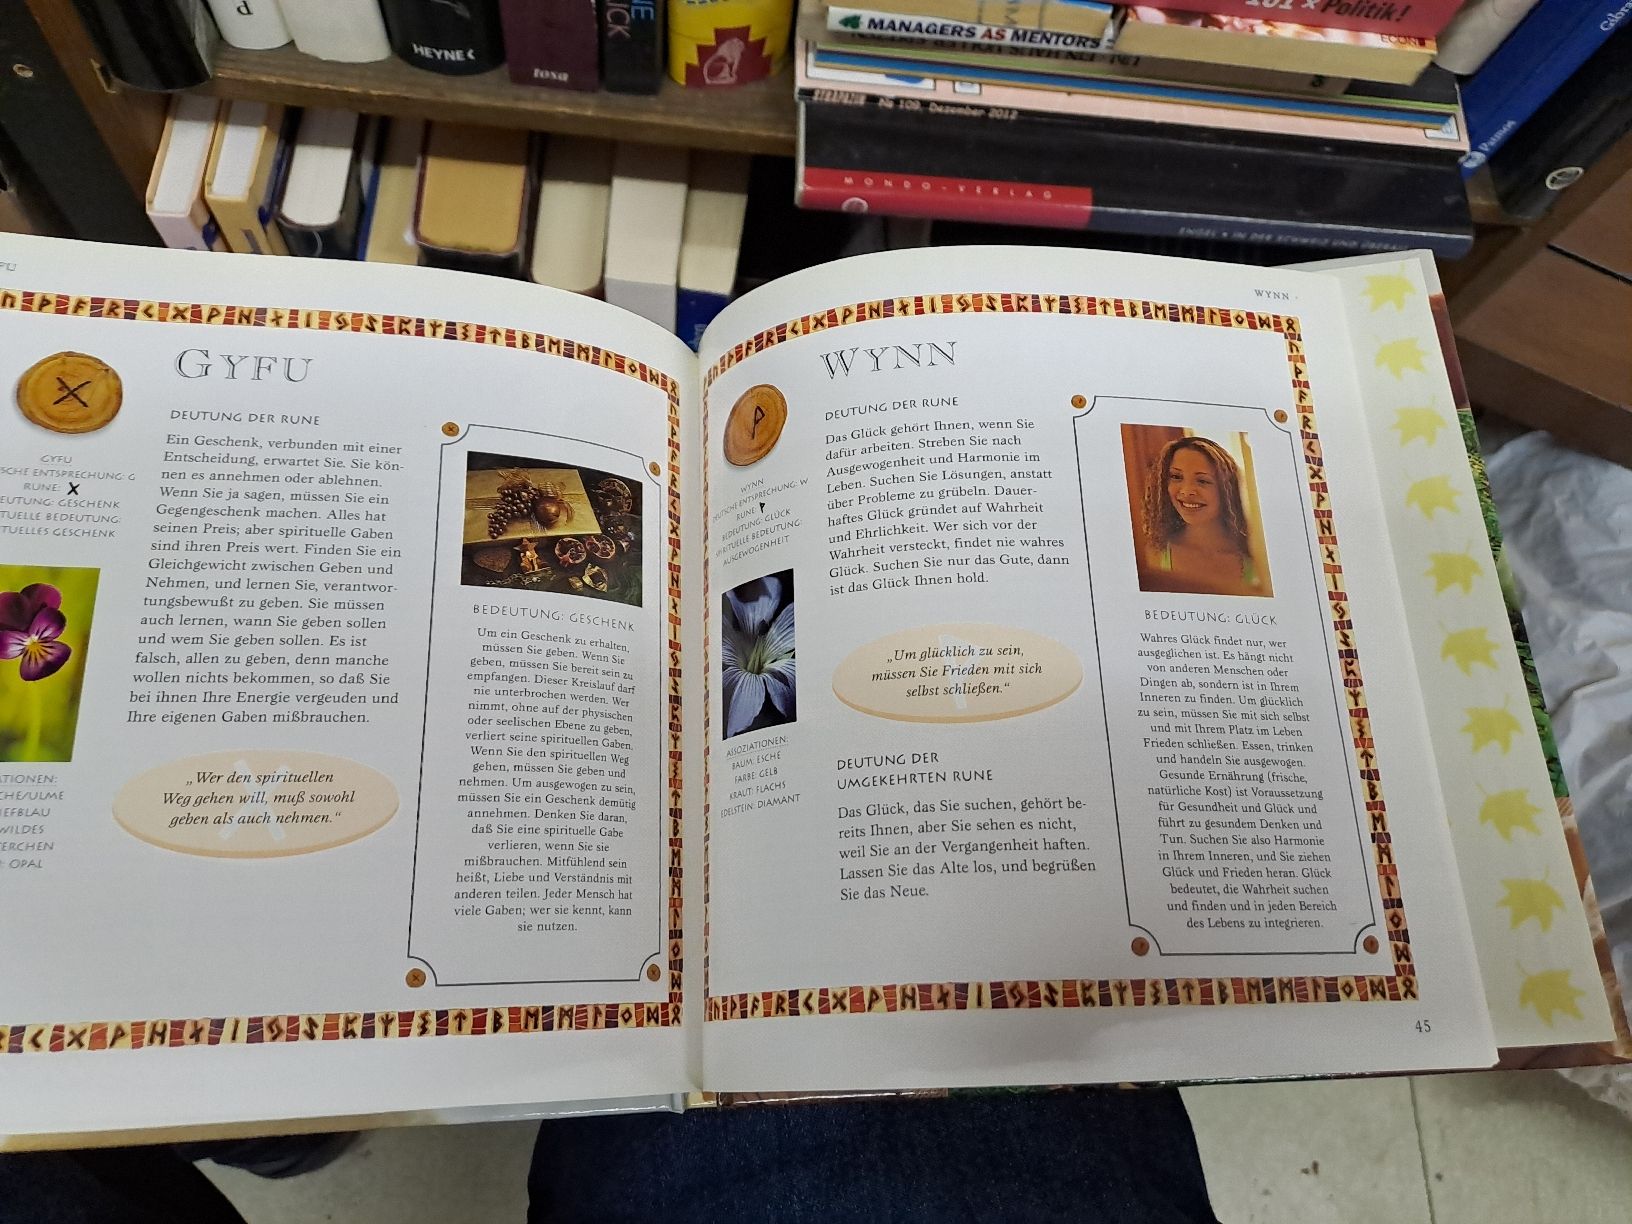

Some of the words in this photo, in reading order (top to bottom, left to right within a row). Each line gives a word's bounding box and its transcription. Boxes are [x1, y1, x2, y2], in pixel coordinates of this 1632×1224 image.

[1320, 0, 1411, 23] Politik!
[867, 18, 977, 38] MANAGERS
[981, 27, 1006, 41] AS
[1010, 30, 1100, 49] MENTORS
[412, 42, 466, 61] HEYNE
[1255, 289, 1289, 300] WYNN
[174, 349, 314, 383] GYFU
[820, 342, 957, 380] WYNN
[825, 403, 888, 420] DEUTUNG
[893, 400, 917, 410] DER
[922, 397, 959, 407] RUNE
[170, 410, 242, 422] DEUTUNG
[248, 413, 275, 424] DER
[281, 414, 320, 426] RUNE
[166, 435, 189, 445] Ein
[194, 436, 263, 449] Geschenk,
[268, 439, 338, 451] verbunden
[343, 442, 364, 453] mit
[368, 444, 402, 454] einer
[40, 454, 72, 463] GYFU
[827, 455, 925, 478] Ausgewogenheit
[929, 453, 953, 464] und
[958, 453, 1020, 463] Harmonie
[1024, 453, 1040, 462] im
[58, 499, 120, 508] GESCHENK
[156, 504, 261, 519] Gegengeschenk
[266, 508, 321, 519] machen.
[326, 510, 360, 521] Alles
[365, 510, 386, 522] hat
[765, 508, 791, 522] GLÜCK
[53, 528, 116, 538] GESCHENK
[830, 544, 885, 561] Wahrheit
[889, 539, 950, 553] versteckt,
[954, 537, 992, 549] findet
[996, 538, 1015, 547] nie
[1020, 538, 1064, 547] wahres
[473, 604, 565, 621] BEDEUTUNG:
[569, 613, 635, 632] GESCHENK
[1144, 610, 1231, 623] BEDEUTUNG:
[1235, 612, 1278, 625] GLÜCK
[477, 628, 497, 638] Um
[500, 630, 517, 639] ein
[520, 630, 571, 644] Geschenk
[574, 636, 586, 645] zu
[589, 638, 630, 654] erhalten,
[1140, 632, 1178, 644] Wahres
[1180, 634, 1211, 645] Glück
[1213, 635, 1243, 647] findet
[1246, 639, 1266, 648] nur,
[1269, 639, 1287, 648] wer
[919, 646, 975, 662] glücklich
[979, 648, 993, 656] zu
[997, 647, 1024, 657] sein,
[872, 669, 916, 681] müssen
[920, 667, 938, 678] Sie
[942, 665, 990, 677] Frieden
[993, 665, 1015, 675] mit
[1018, 663, 1042, 674] sich
[906, 685, 939, 697] selbst
[128, 711, 157, 724] Ihre
[161, 712, 216, 726] eigenen
[221, 711, 267, 723] Gaben
[272, 711, 369, 724] mißbrauchen.
[757, 751, 781, 763] ESCHE
[837, 753, 906, 770] DEUTUNG
[912, 752, 939, 764] DER
[227, 771, 252, 784] den
[255, 771, 334, 786] spirituellen
[759, 767, 778, 778] GELB
[837, 771, 946, 790] UMGEKEHRTEN
[953, 770, 993, 781] RUNE
[756, 781, 786, 794] FLACHS
[1147, 785, 1202, 797] natürliche
[1205, 786, 1232, 798] Kost)
[1235, 787, 1248, 798] ist
[1251, 787, 1323, 801] Voraussetzung
[163, 793, 193, 807] Weg
[193, 793, 234, 807] gehen
[239, 791, 269, 806] will,
[273, 790, 305, 805] muß
[309, 790, 356, 804] sowohl
[458, 793, 500, 803] müssen
[504, 793, 521, 803] Sie
[525, 794, 541, 803] ein
[545, 794, 595, 806] Geschenk
[599, 797, 636, 810] demütig
[757, 794, 801, 809] DIAMANT
[168, 813, 209, 828] geben
[213, 812, 234, 825] als
[237, 812, 271, 825] auch
[0, 842, 54, 851] ERCHEN
[840, 846, 866, 859] weil
[870, 845, 890, 856] Sie
[894, 846, 910, 855] an
[915, 843, 936, 854] der
[941, 839, 1039, 855] Vergangenheit
[1043, 838, 1090, 851] haften.
[9, 859, 42, 868] OPAL
[840, 888, 860, 900] Sie
[864, 887, 886, 899] das
[891, 886, 929, 897] Neue.
[517, 921, 533, 931] sie
[537, 922, 577, 932] nutzen.
[1187, 918, 1204, 929] des
[1208, 918, 1246, 929] Lebens
[1248, 920, 1261, 929] zu
[1264, 917, 1323, 932] integrieren.
[1415, 1019, 1431, 1032] 45
